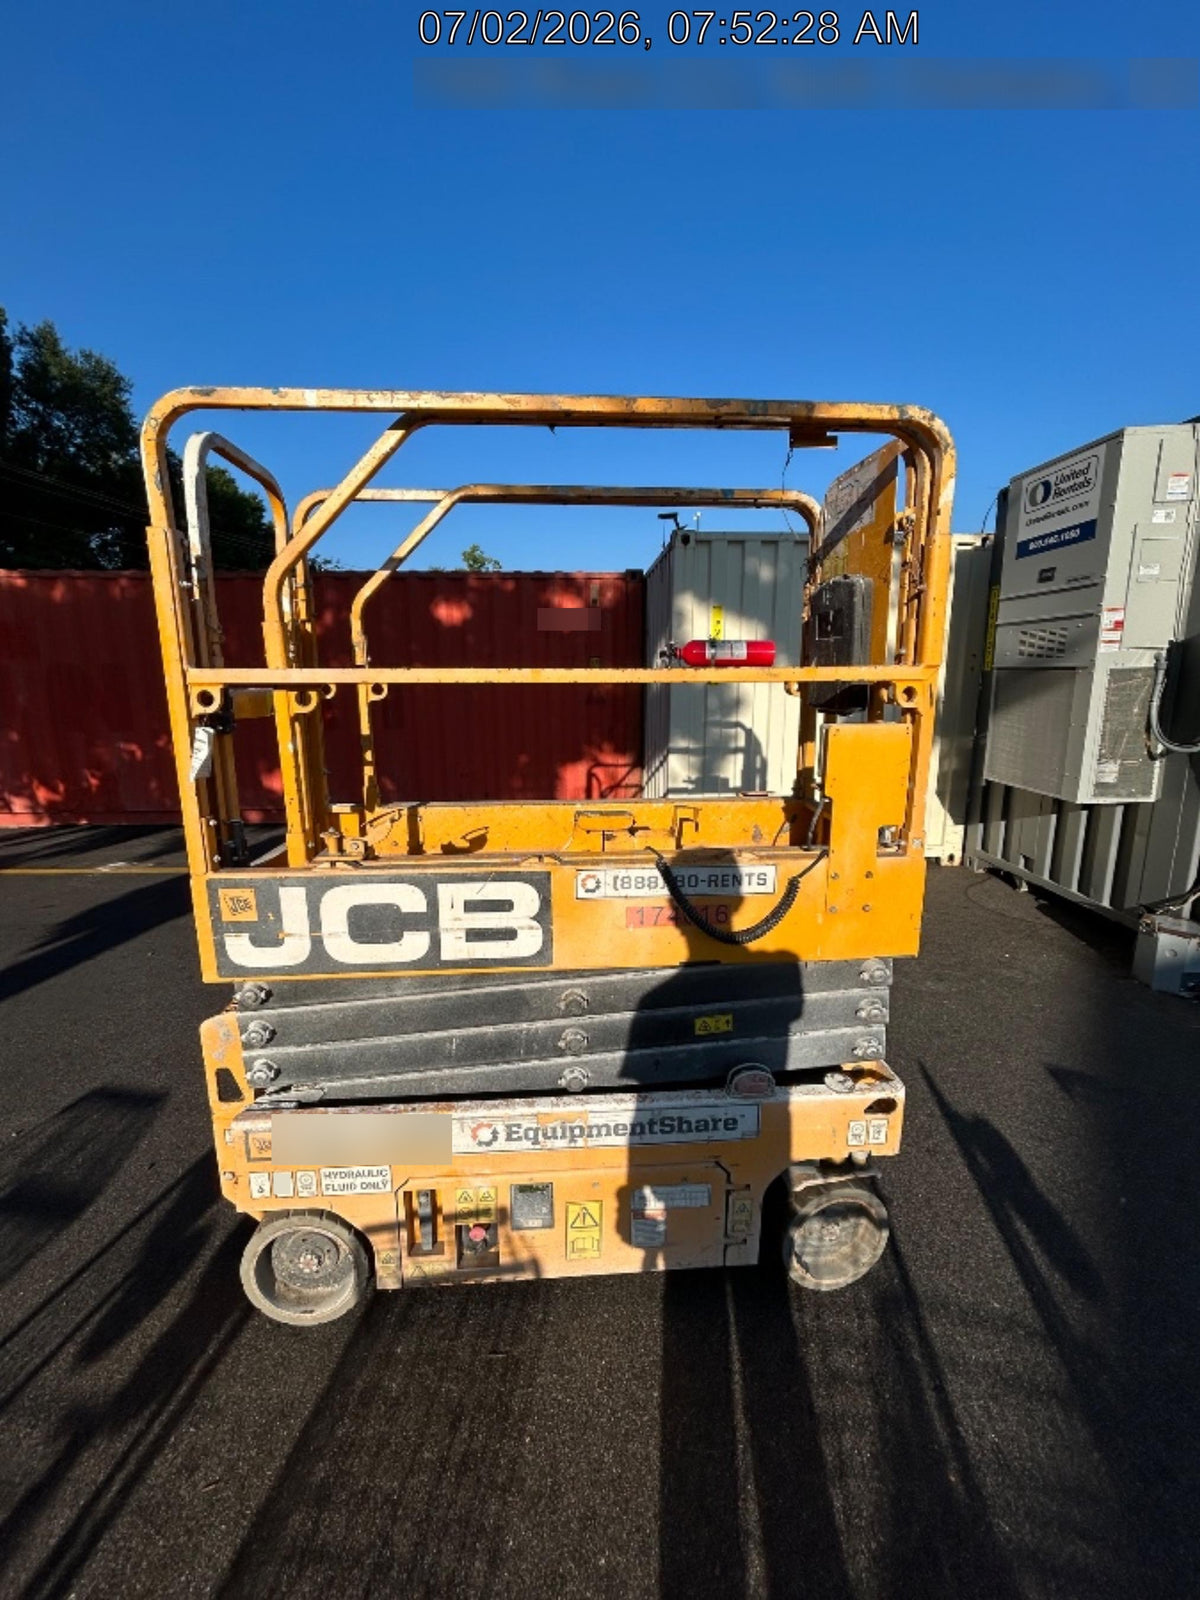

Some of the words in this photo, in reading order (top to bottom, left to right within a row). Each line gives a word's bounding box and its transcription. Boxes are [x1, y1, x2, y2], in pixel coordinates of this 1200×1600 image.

[224, 881, 543, 967] JCB
[636, 904, 729, 926] 17416
[504, 1115, 738, 1147] EquipmentShare
[323, 1168, 389, 1180] HYDRAULIC
[324, 1182, 357, 1192] FLUID
[360, 1179, 389, 1191] ONLY
